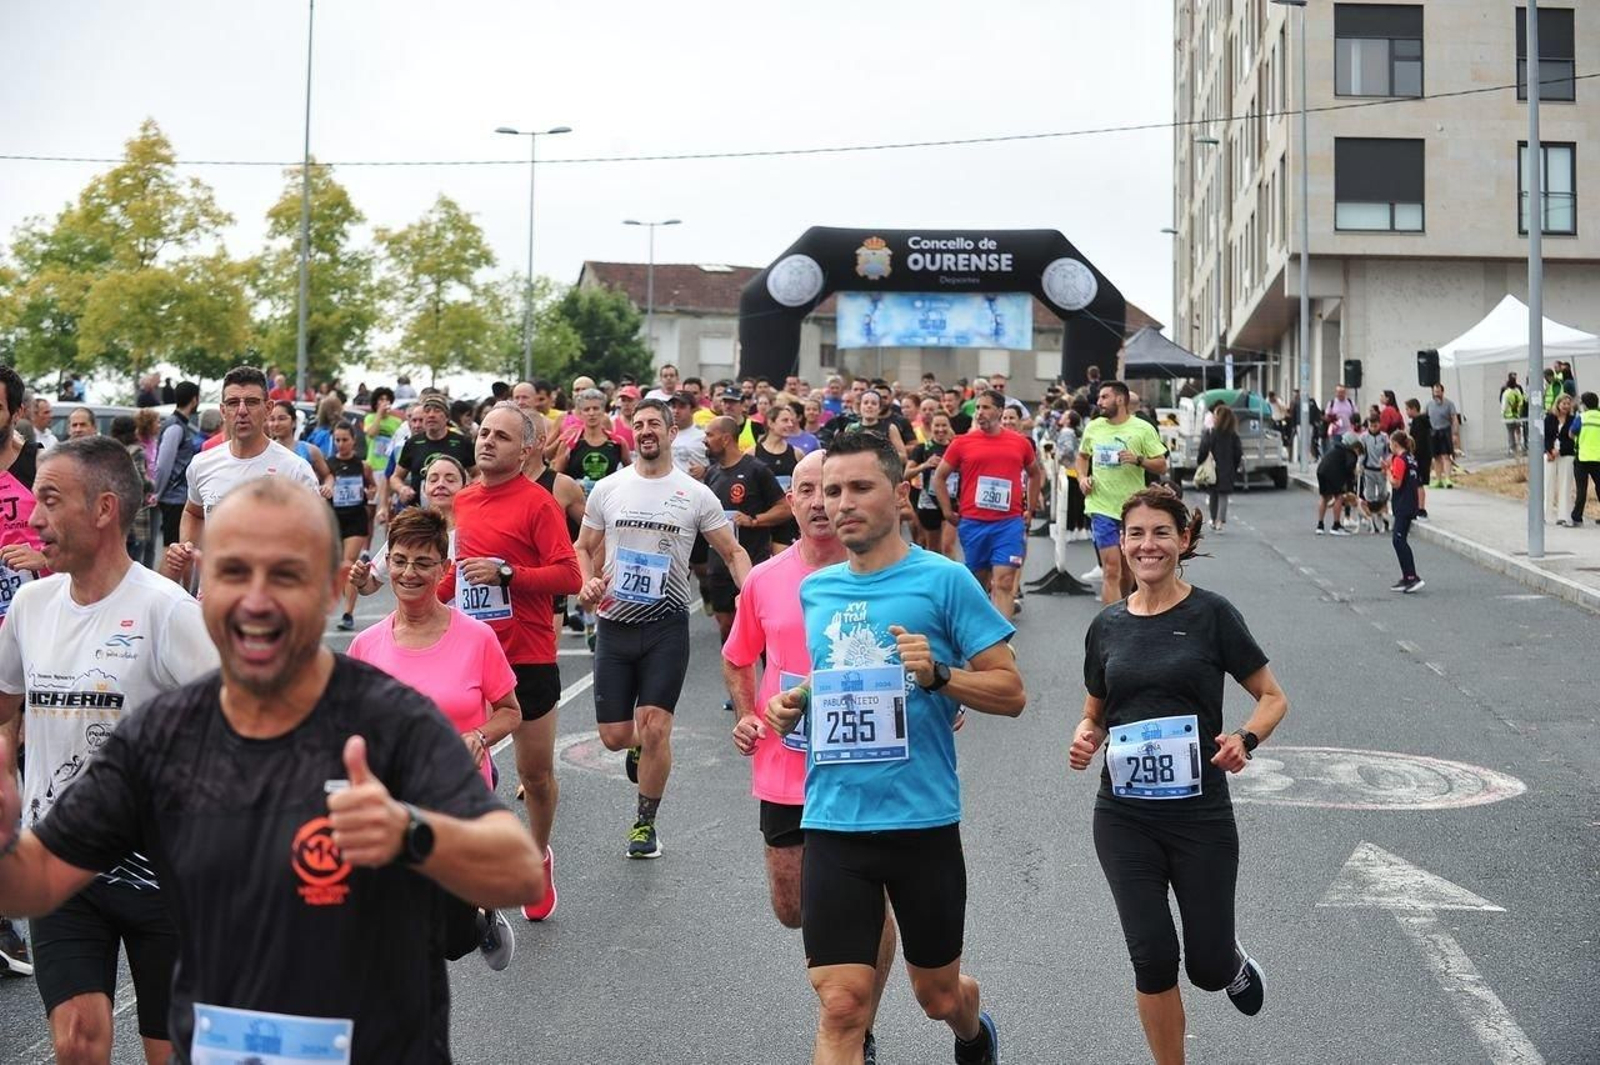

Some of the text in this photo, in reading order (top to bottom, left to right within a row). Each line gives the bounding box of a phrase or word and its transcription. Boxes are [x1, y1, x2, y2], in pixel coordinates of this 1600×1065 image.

[907, 236, 998, 250] Concello de
[907, 252, 1013, 272] OURENSE
[621, 571, 652, 594] 279
[462, 586, 492, 610] 302
[826, 709, 876, 744] 255
[1126, 754, 1175, 783] 298
